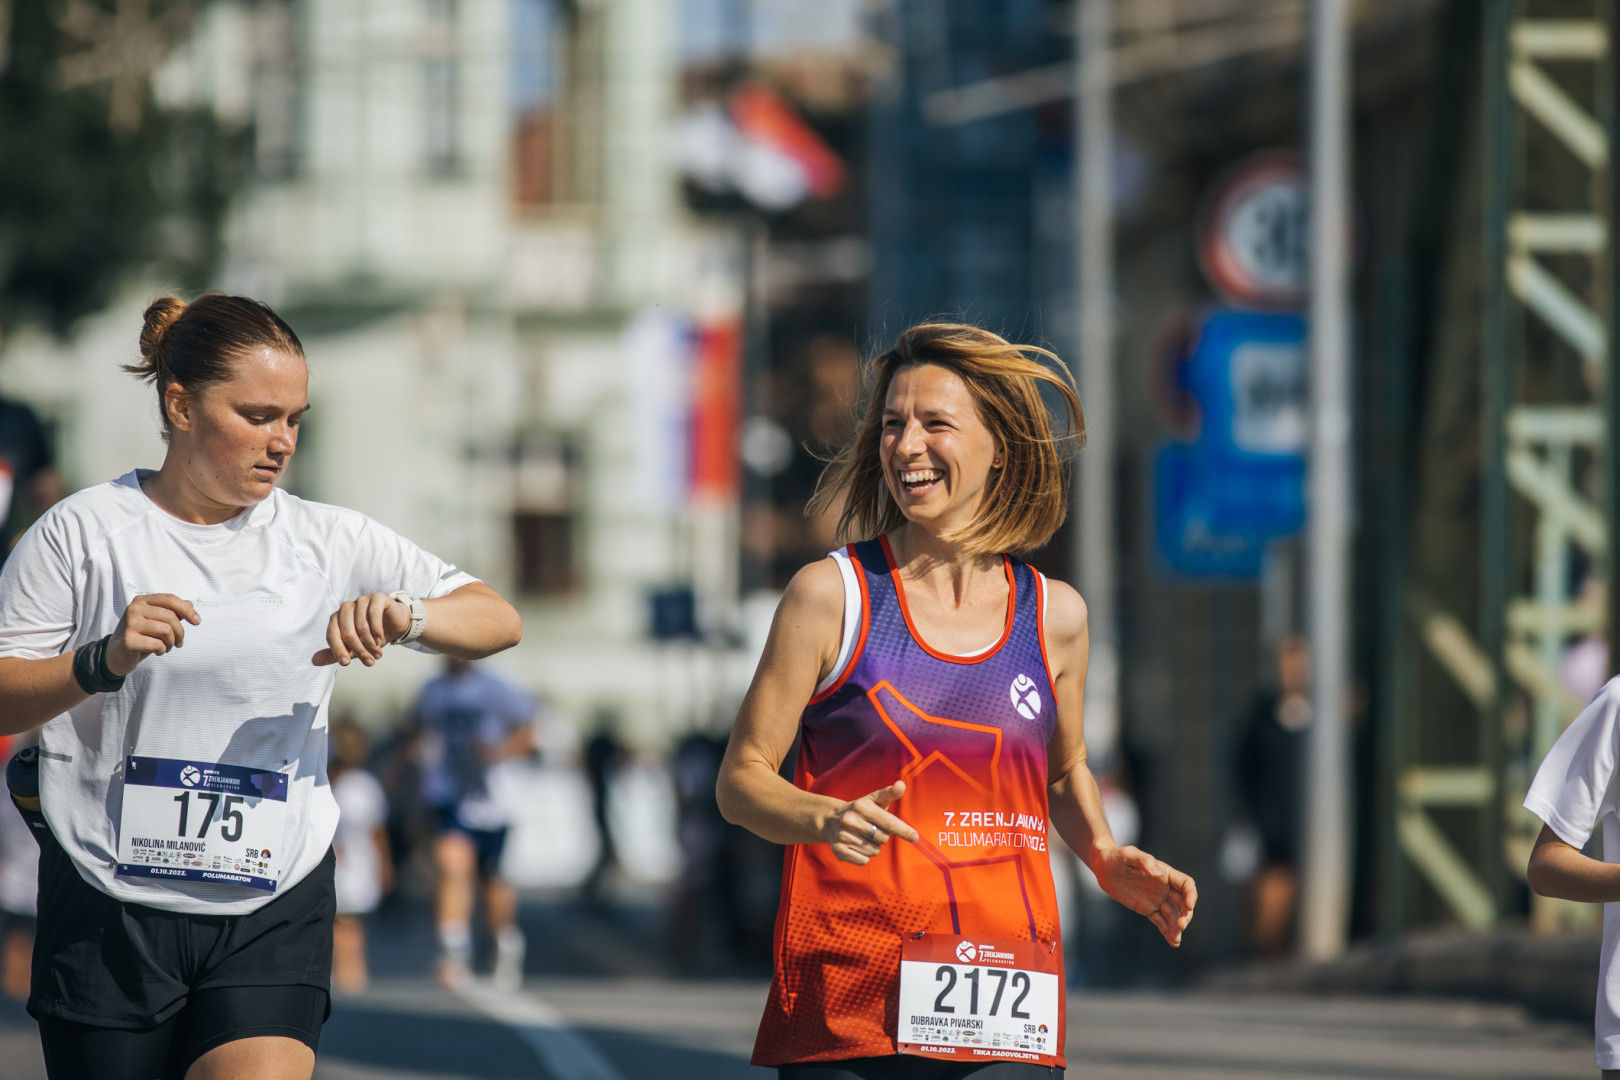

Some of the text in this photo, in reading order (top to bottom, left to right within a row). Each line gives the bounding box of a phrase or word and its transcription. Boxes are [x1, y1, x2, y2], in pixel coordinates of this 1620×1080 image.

[174, 791, 243, 842] 175
[943, 811, 955, 826] 7.
[131, 837, 164, 850] NIKOLINA
[166, 840, 206, 853] MILANOVIĆ
[938, 831, 1030, 848] POLUMARATON
[245, 848, 259, 859] SRB
[150, 868, 252, 883] 01.10.2023. POLUMARATON
[934, 965, 1031, 1019] 2172
[911, 1015, 984, 1029] DUBRAVKA PIVARSKI
[1023, 1023, 1037, 1034] SRB
[920, 1045, 1040, 1061] 01.10.2023. TRKA ZADOVOLJSTVA
